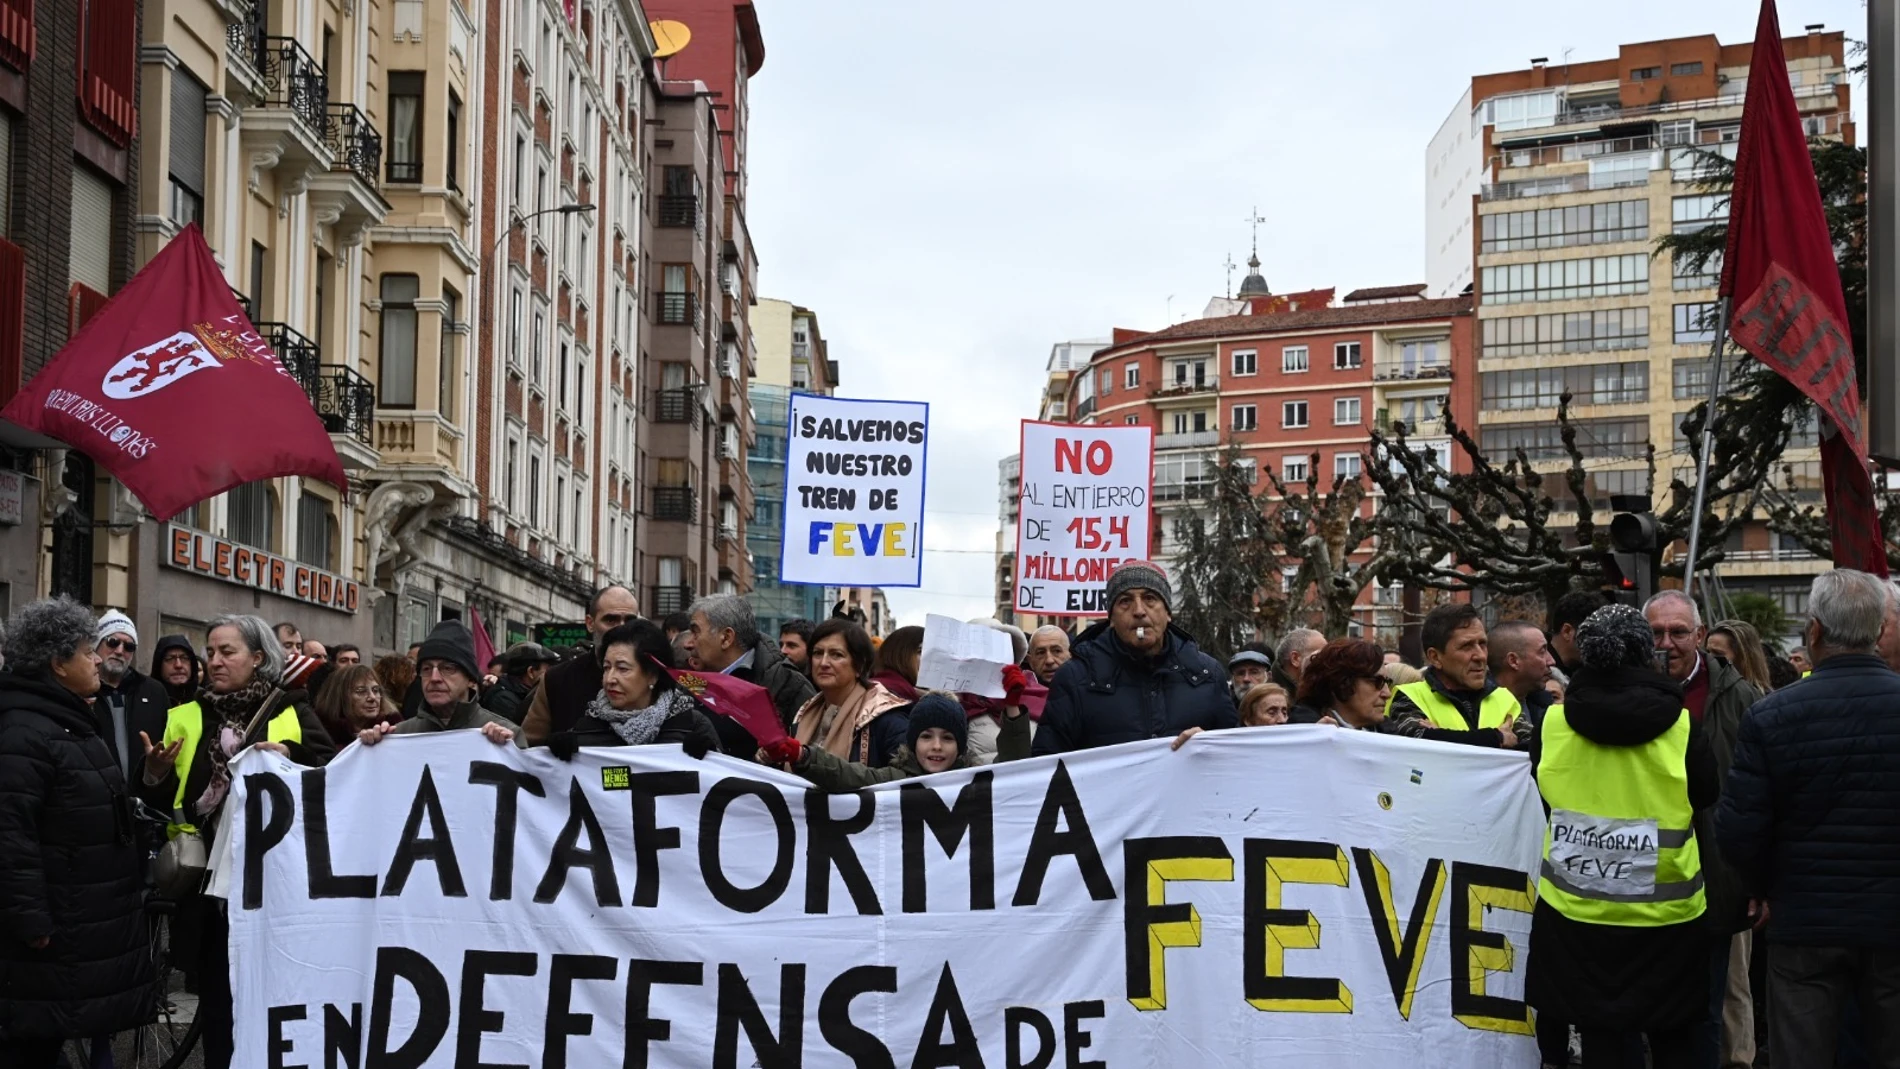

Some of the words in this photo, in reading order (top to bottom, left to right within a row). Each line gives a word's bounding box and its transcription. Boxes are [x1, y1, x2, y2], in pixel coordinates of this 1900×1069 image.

[806, 451, 913, 476] NUESTRO
[1055, 438, 1113, 476] NO
[798, 485, 856, 511] TREN
[869, 488, 898, 511] DE
[1021, 481, 1044, 506] AL
[1026, 518, 1051, 541] DE
[1066, 515, 1130, 552] 15,4
[1020, 586, 1044, 609] DE
[242, 759, 1116, 915] PLATAFORMA
[1554, 825, 1655, 851] PLATAFORMA
[1565, 855, 1633, 880] FEVE
[1124, 836, 1535, 1036] FEVE
[268, 1003, 362, 1069] EN
[1004, 999, 1107, 1069] DE
